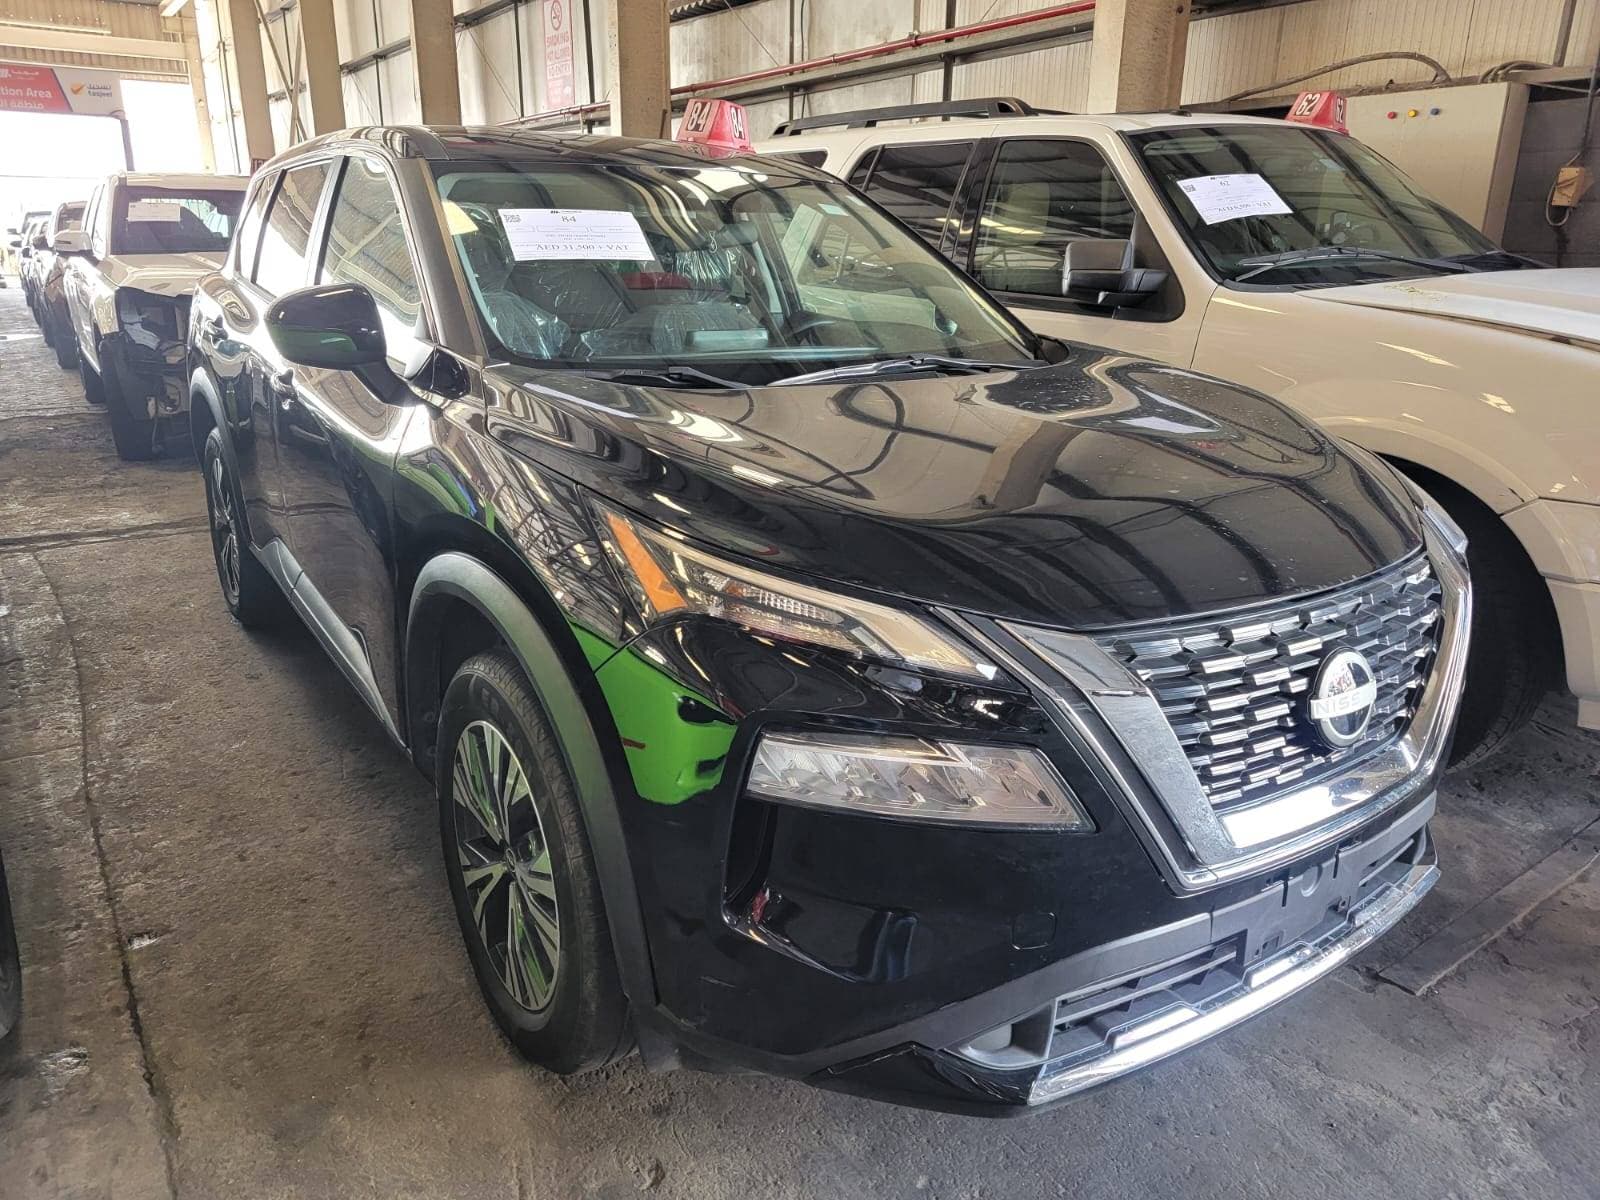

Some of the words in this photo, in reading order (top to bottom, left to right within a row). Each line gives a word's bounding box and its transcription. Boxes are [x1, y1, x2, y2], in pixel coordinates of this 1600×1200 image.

[26, 88, 52, 98] Area
[1296, 93, 1320, 115] 62
[687, 102, 711, 131] 84
[731, 107, 744, 139] 84
[561, 215, 576, 223] 84
